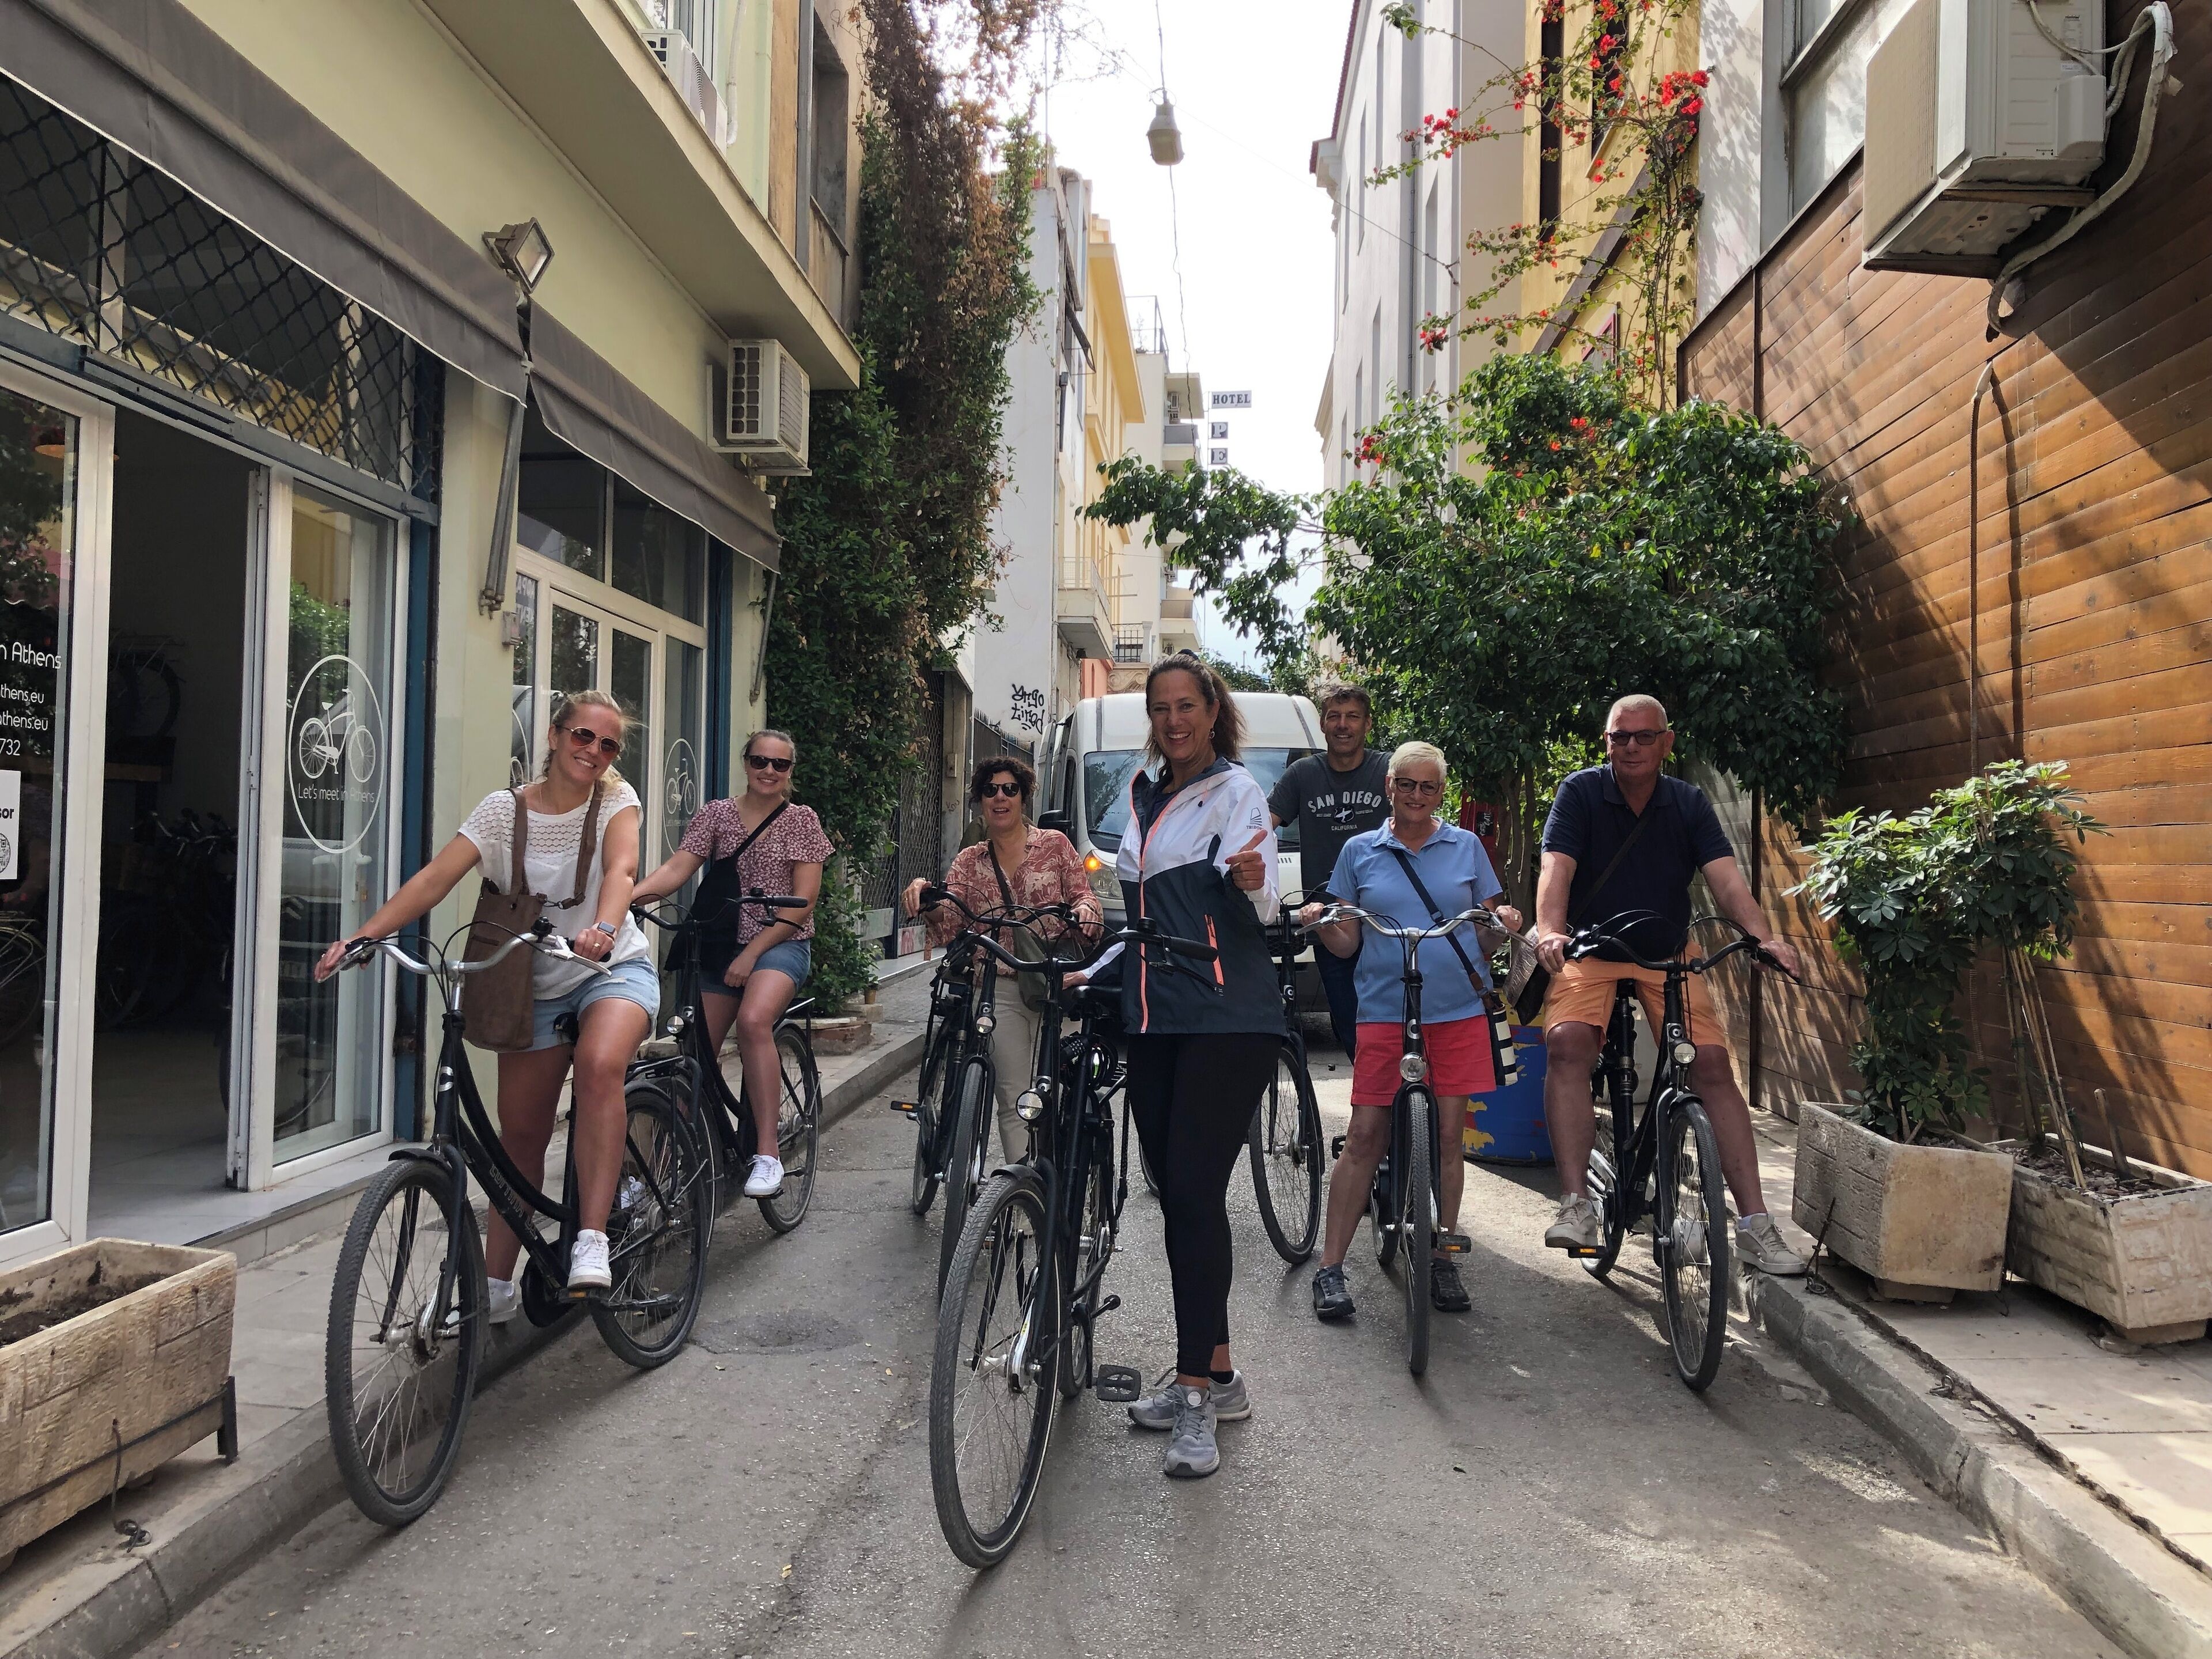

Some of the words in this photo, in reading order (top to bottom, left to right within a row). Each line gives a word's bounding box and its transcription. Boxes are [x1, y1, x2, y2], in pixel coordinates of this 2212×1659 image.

[1213, 394, 1251, 404] HOTEL
[12, 641, 62, 669] Athens
[298, 783, 317, 799] Let's
[319, 787, 339, 801] meet
[1308, 794, 1335, 813] SAN
[1342, 790, 1382, 808] DIEGO
[0, 808, 14, 819] or
